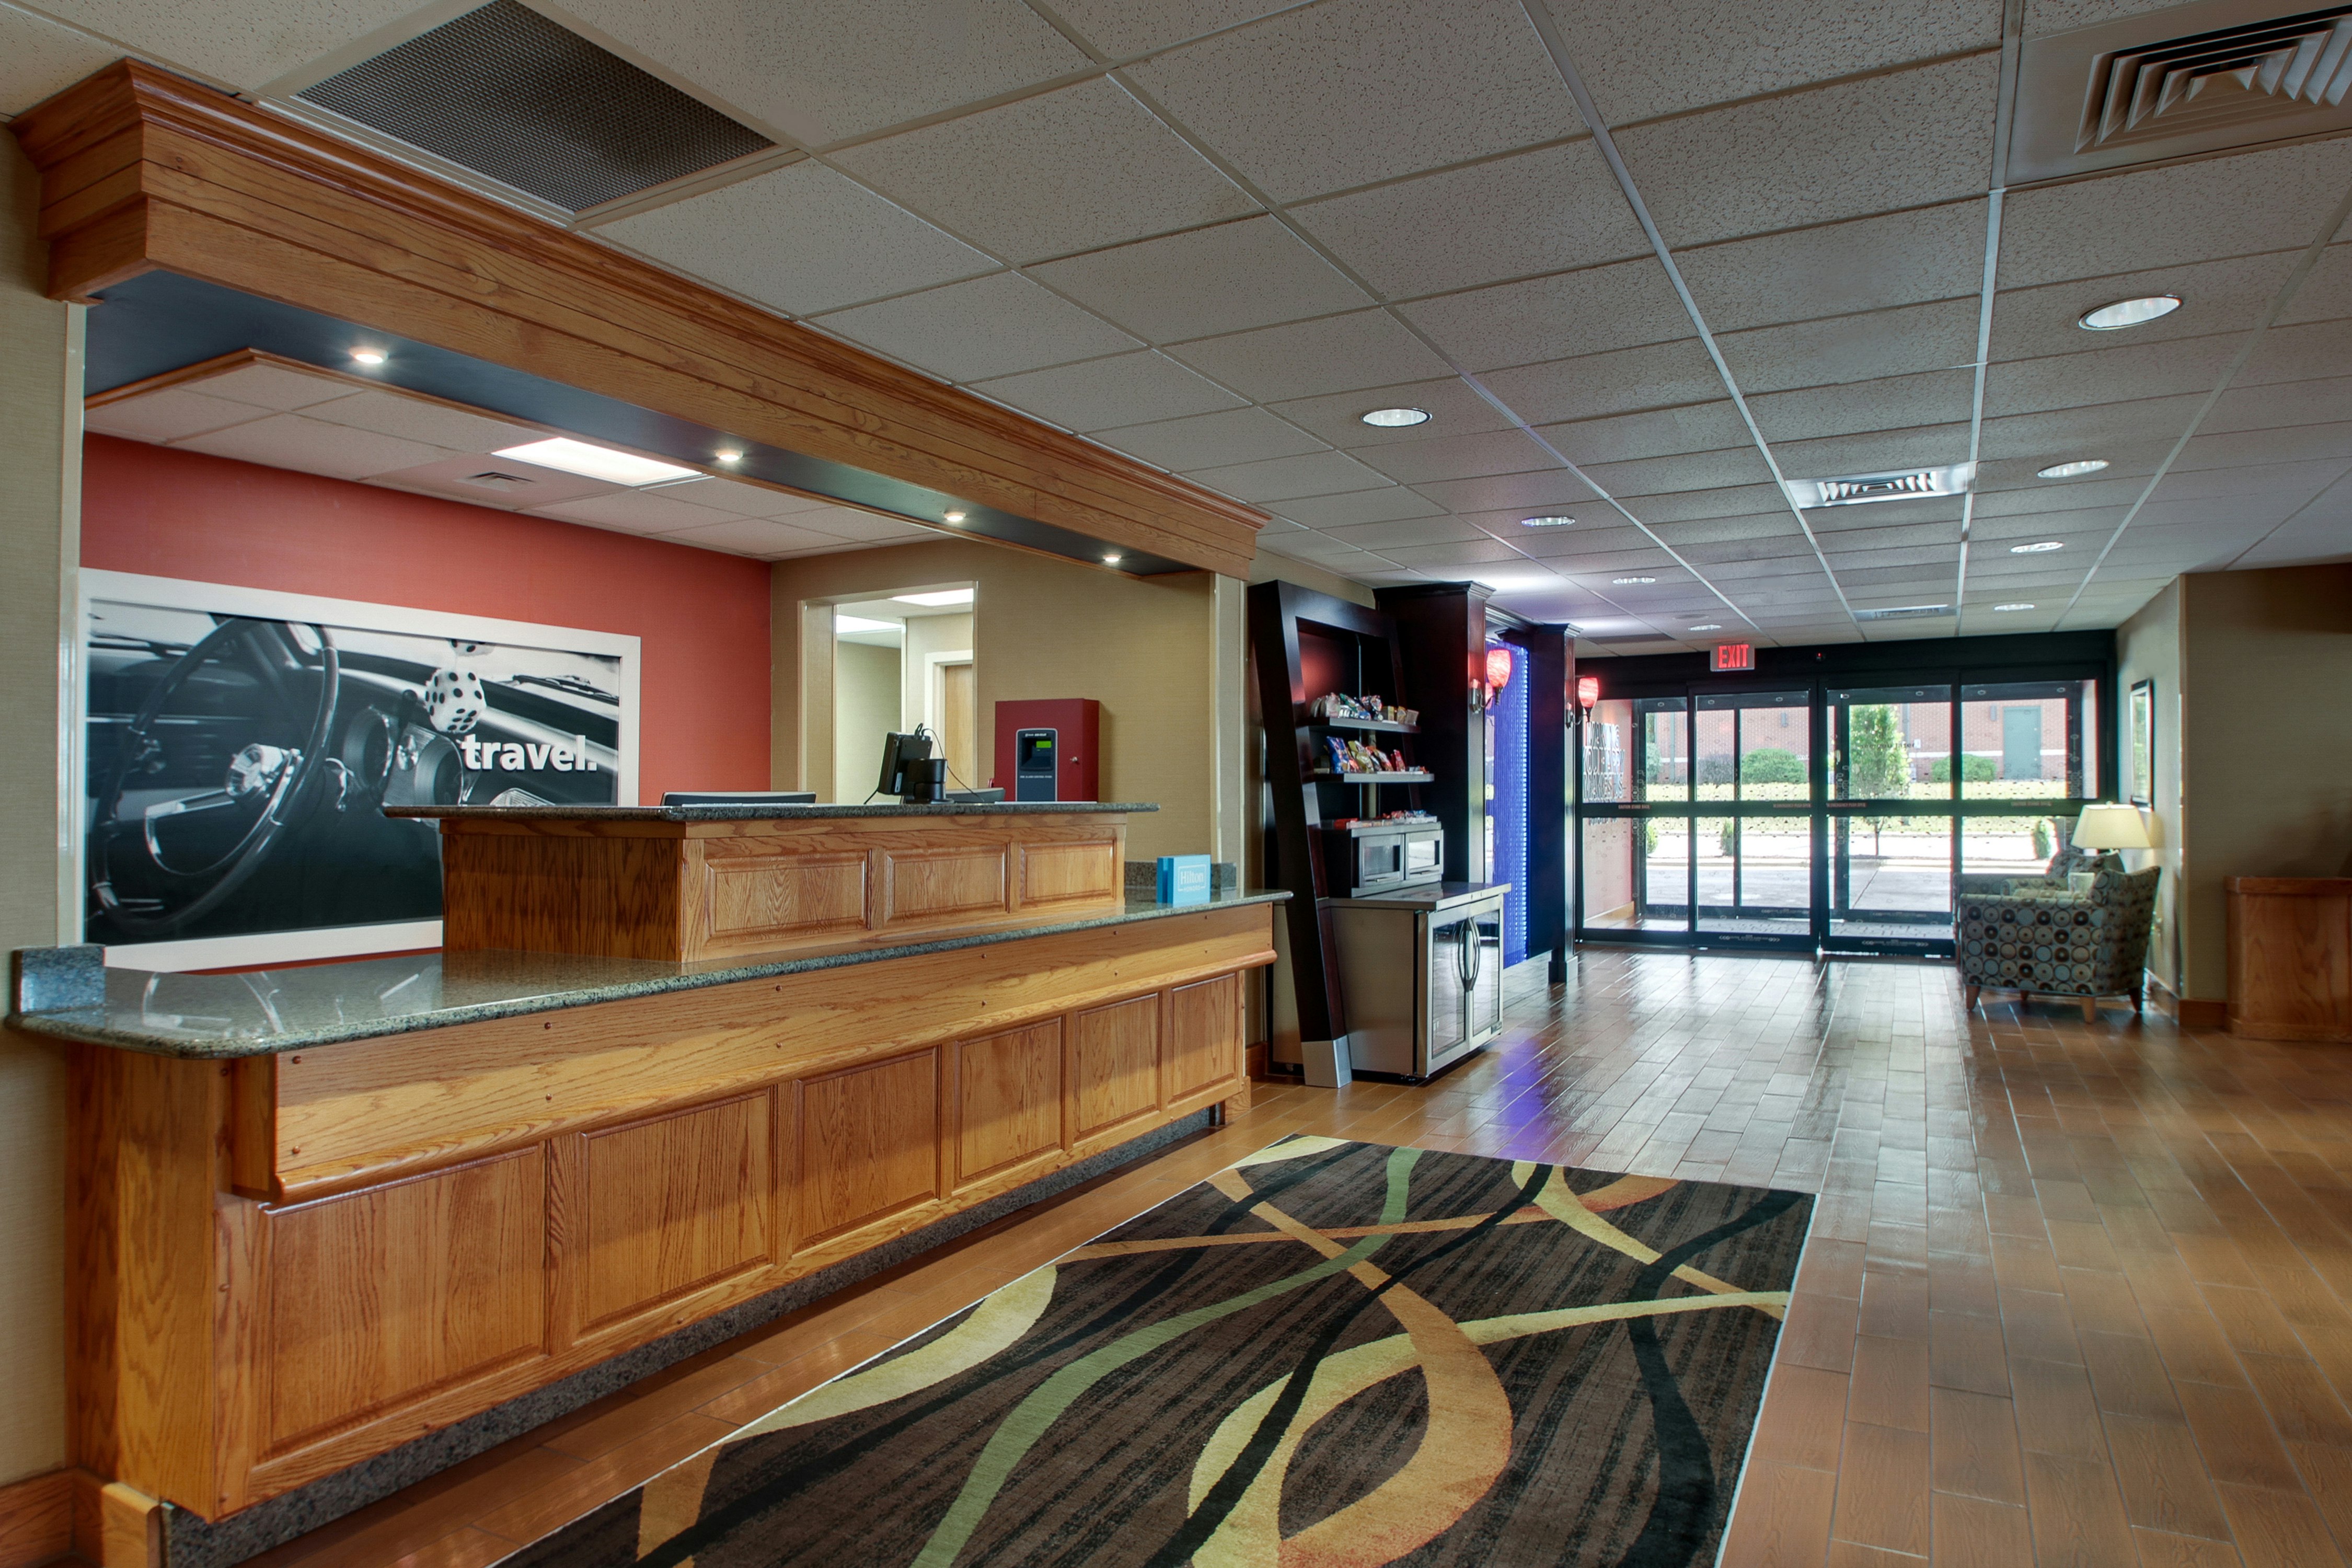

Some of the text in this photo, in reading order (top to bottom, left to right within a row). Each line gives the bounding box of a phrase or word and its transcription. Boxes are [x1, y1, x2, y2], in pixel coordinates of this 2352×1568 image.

[1719, 644, 1749, 668] EXIT
[1586, 722, 1620, 750] MAKING
[461, 734, 597, 771] travel.
[1180, 871, 1204, 884] Hilton
